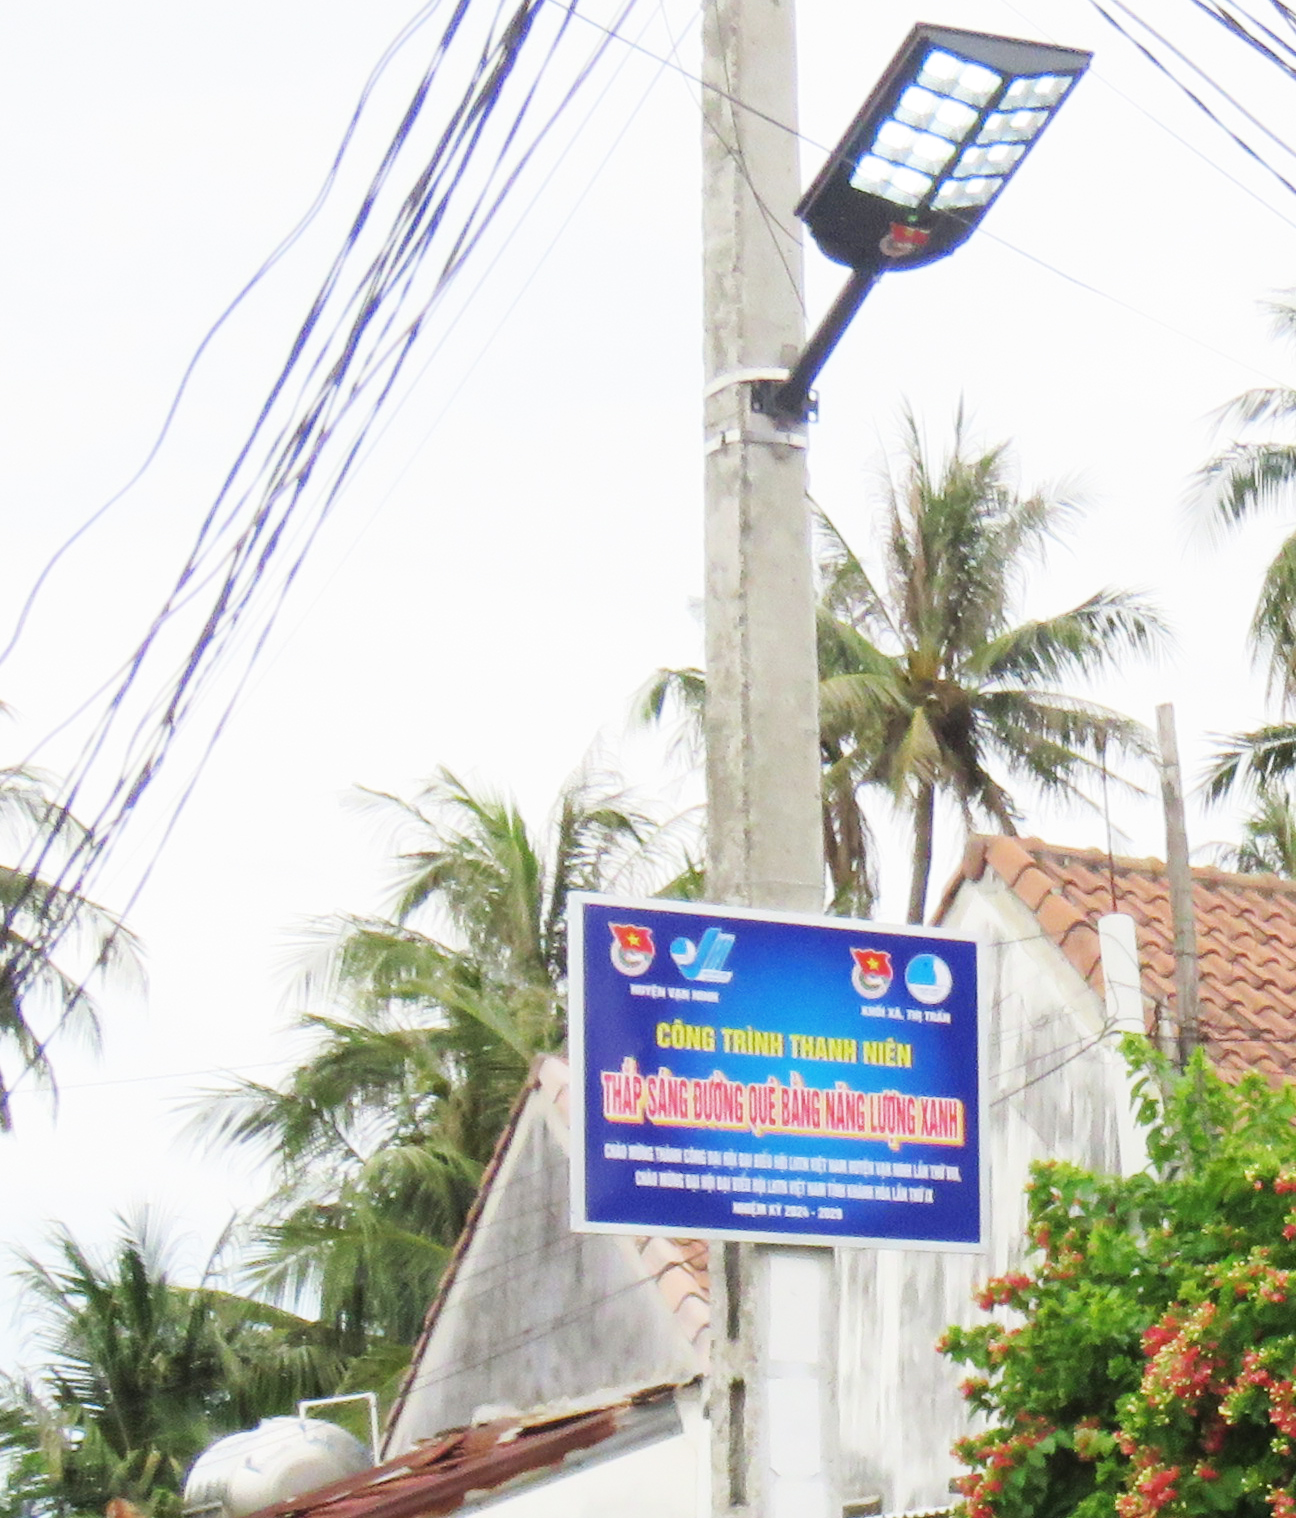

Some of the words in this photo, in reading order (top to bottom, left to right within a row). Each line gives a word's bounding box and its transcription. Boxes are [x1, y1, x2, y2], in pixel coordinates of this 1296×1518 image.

[656, 1018, 716, 1052] CÔNG
[720, 1025, 784, 1057] TRÌNH
[789, 1034, 857, 1064] THANH
[863, 1037, 913, 1068] NIÊN
[647, 1066, 690, 1121] SÁNG
[691, 1069, 745, 1125] ĐƯỜNG
[747, 1075, 778, 1136] QUÊ
[780, 1070, 822, 1131] BẰNG
[824, 1080, 867, 1134] NĂNG
[868, 1089, 917, 1151] LƯỢNG
[918, 1096, 962, 1141] XANH
